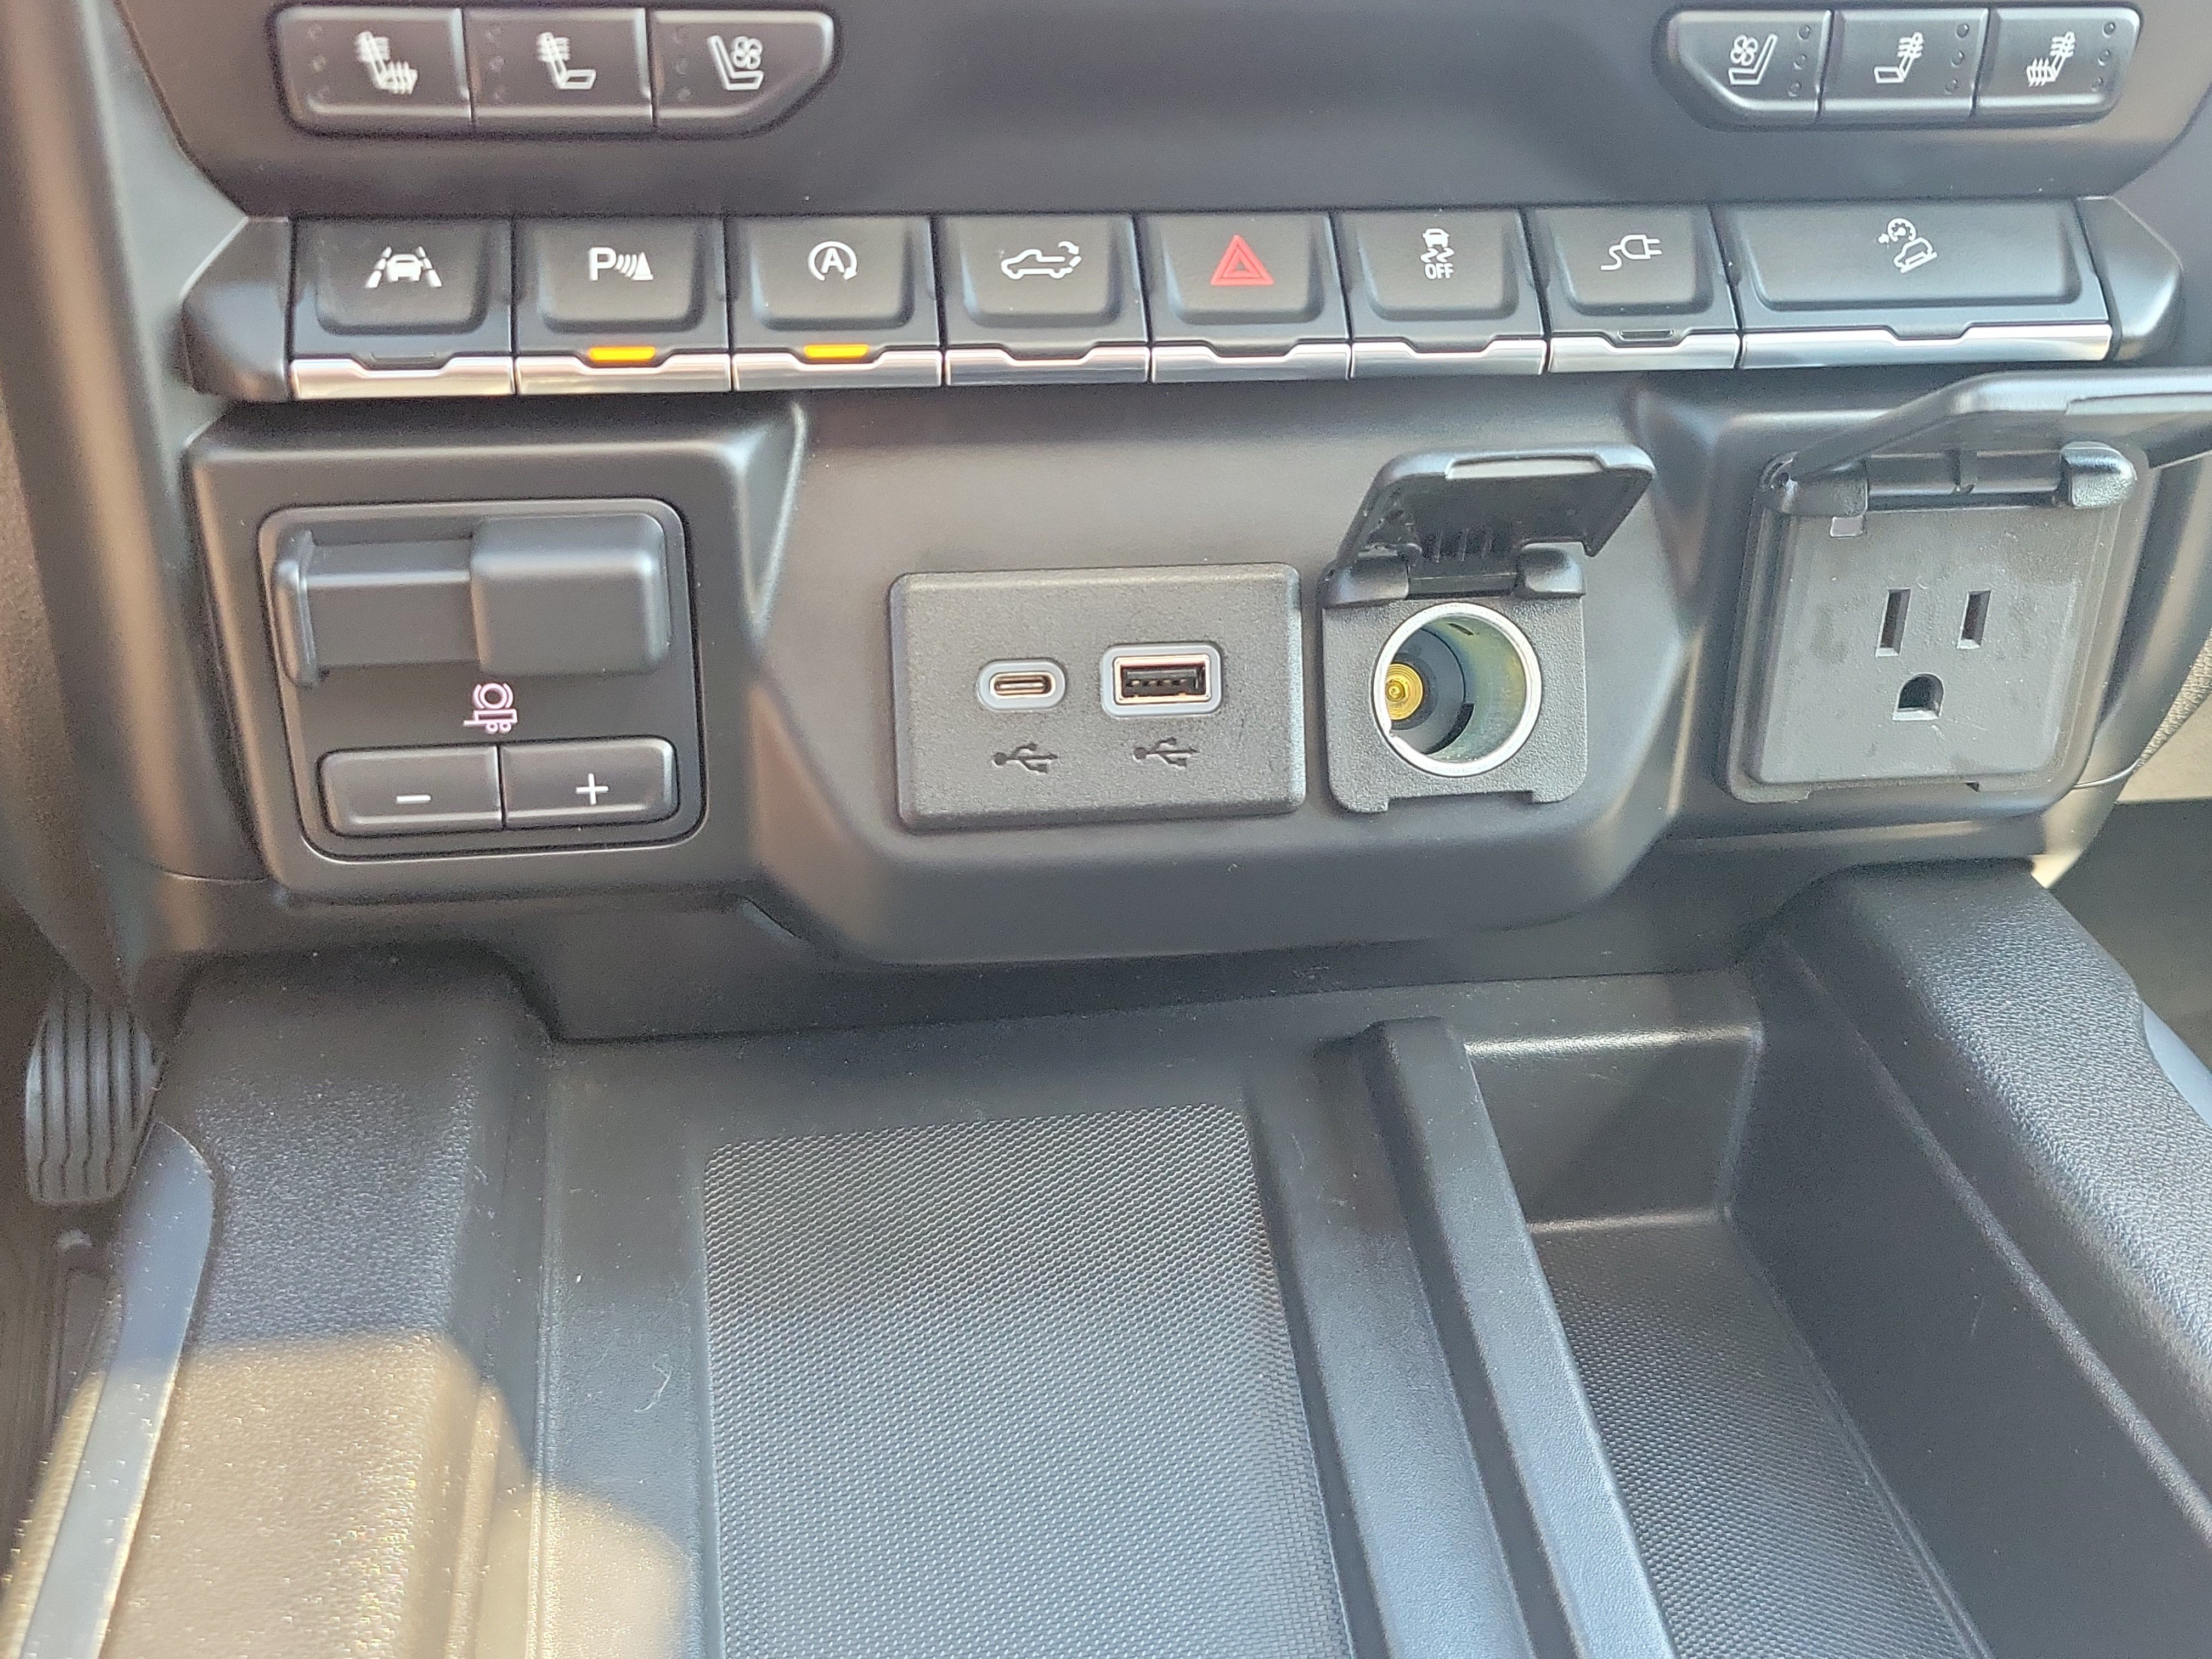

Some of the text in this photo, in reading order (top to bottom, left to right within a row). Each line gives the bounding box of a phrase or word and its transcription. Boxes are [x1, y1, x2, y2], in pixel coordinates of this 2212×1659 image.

[589, 247, 616, 281] P
[821, 247, 845, 274] A
[1425, 263, 1454, 279] OFF
